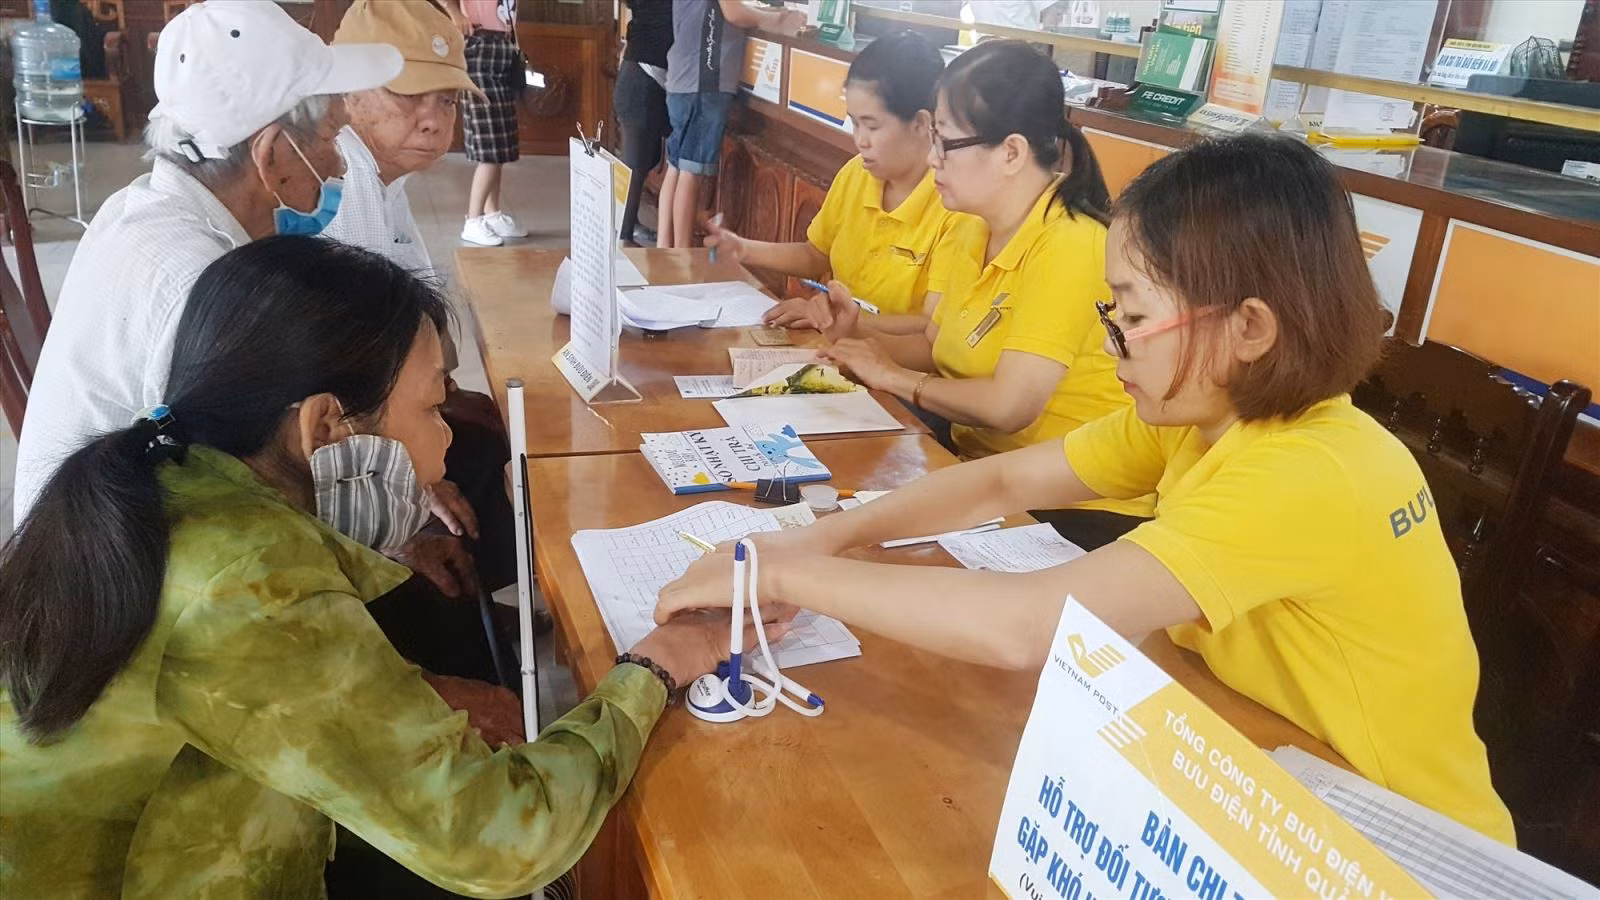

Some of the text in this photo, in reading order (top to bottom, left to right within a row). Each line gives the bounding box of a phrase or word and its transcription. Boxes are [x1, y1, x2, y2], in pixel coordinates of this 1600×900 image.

[1141, 91, 1186, 105] FE CREDIT
[741, 453, 761, 472] CHI
[1054, 654, 1119, 715] VIETNAM POST
[1038, 775, 1066, 818] HỖ
[1063, 799, 1099, 860] TRỢ
[1094, 835, 1131, 892] ĐỐI
[1164, 710, 1207, 754] TỔNG
[1208, 748, 1256, 794] CÔNG
[1260, 788, 1284, 816] TY
[1284, 812, 1326, 853] BƯU
[1325, 846, 1376, 898] ĐIỆN
[1171, 749, 1209, 790] BƯU
[1209, 783, 1255, 832] ĐIỆN
[1258, 823, 1302, 873] TỈNH
[1017, 816, 1083, 900] GẶP KHÓ
[1140, 810, 1228, 900] BÀN CHI
